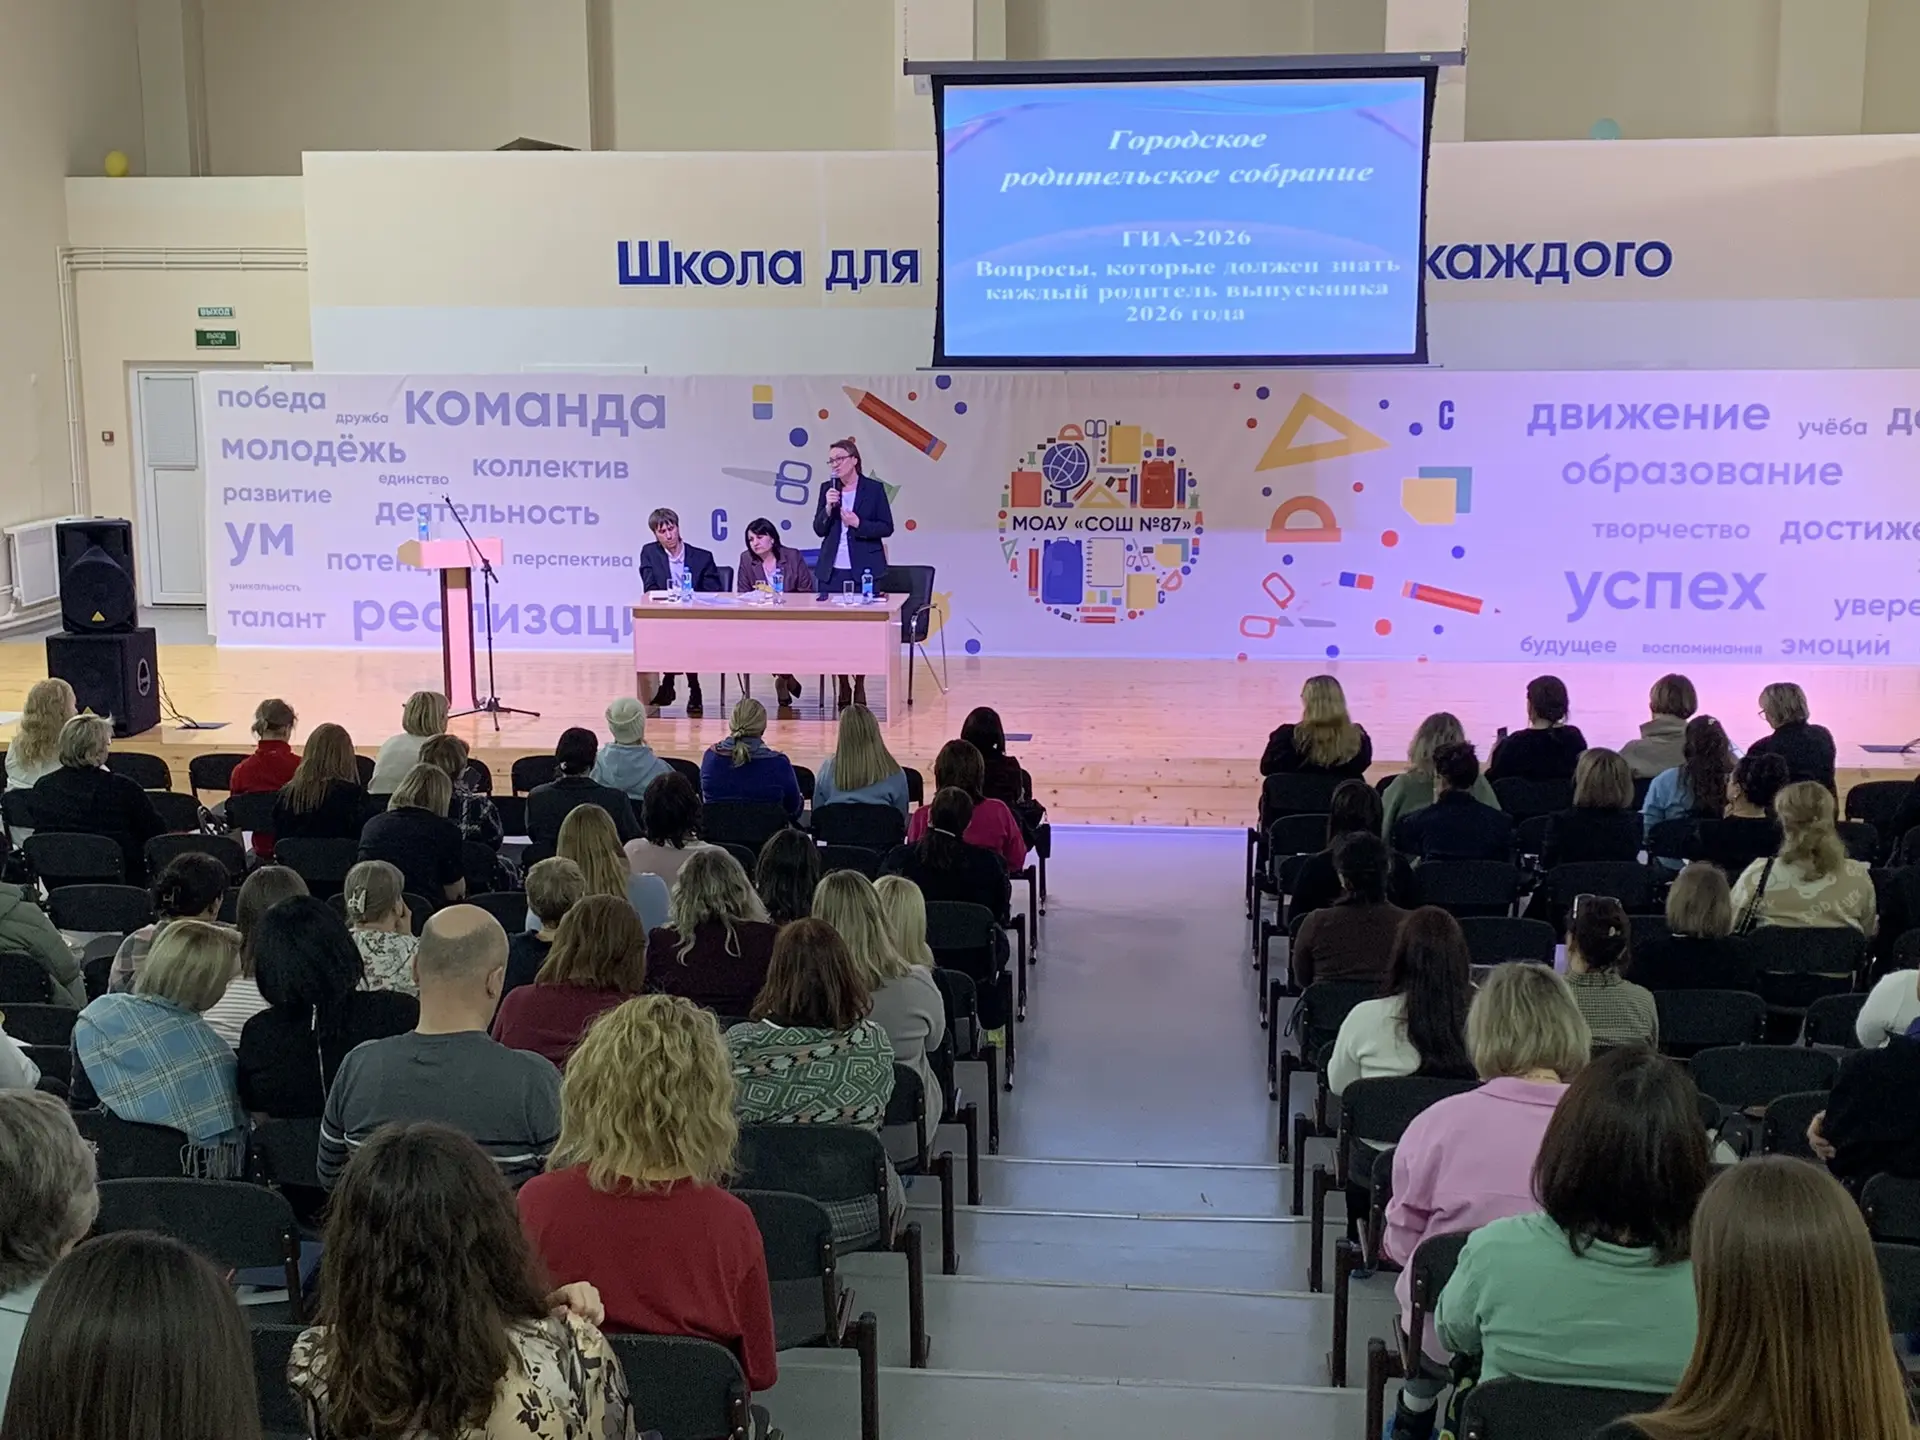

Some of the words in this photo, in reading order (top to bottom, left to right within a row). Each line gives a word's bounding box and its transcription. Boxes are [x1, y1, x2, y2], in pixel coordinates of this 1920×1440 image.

[1108, 129, 1268, 153] Городское
[1000, 166, 1220, 192] родительское
[1228, 163, 1375, 189] собрание
[1122, 229, 1252, 247] ГИА-2026
[617, 240, 802, 286] Школа
[825, 249, 919, 291] для
[1425, 240, 1673, 285] каждого
[976, 260, 1098, 281] Вопросы,
[1106, 262, 1216, 279] которые
[1223, 261, 1319, 276] должен
[1331, 260, 1400, 274] знать
[986, 284, 1089, 301] каждый
[1098, 284, 1218, 304] родитель
[1227, 283, 1389, 301] выпускника
[200, 307, 231, 316] ВЫХОД
[1126, 305, 1183, 322] 2026
[1192, 308, 1245, 323] года
[217, 385, 326, 413] победа
[335, 412, 389, 426] дружба
[405, 390, 666, 437] команда
[1526, 402, 1771, 436] движение
[1797, 417, 1868, 440] учёба
[221, 433, 407, 467] молодёжь
[378, 473, 450, 485] единство
[472, 458, 629, 479] коллектив
[1561, 453, 1843, 493] образование
[223, 486, 333, 506] развитие
[375, 501, 600, 526] деятельность
[1012, 516, 1068, 531] МОАУ
[1074, 516, 1133, 532] «СОШ
[1140, 516, 1191, 532] №87»
[1591, 521, 1751, 544] творчество
[224, 522, 294, 566] ум
[512, 551, 633, 569] перспектива
[229, 583, 302, 592] уникальность
[1563, 570, 1768, 623] успех
[227, 610, 327, 629] талант
[1519, 635, 1617, 657] будущее
[1642, 642, 1763, 655] воспоминания
[1780, 633, 1891, 659] эмоций
